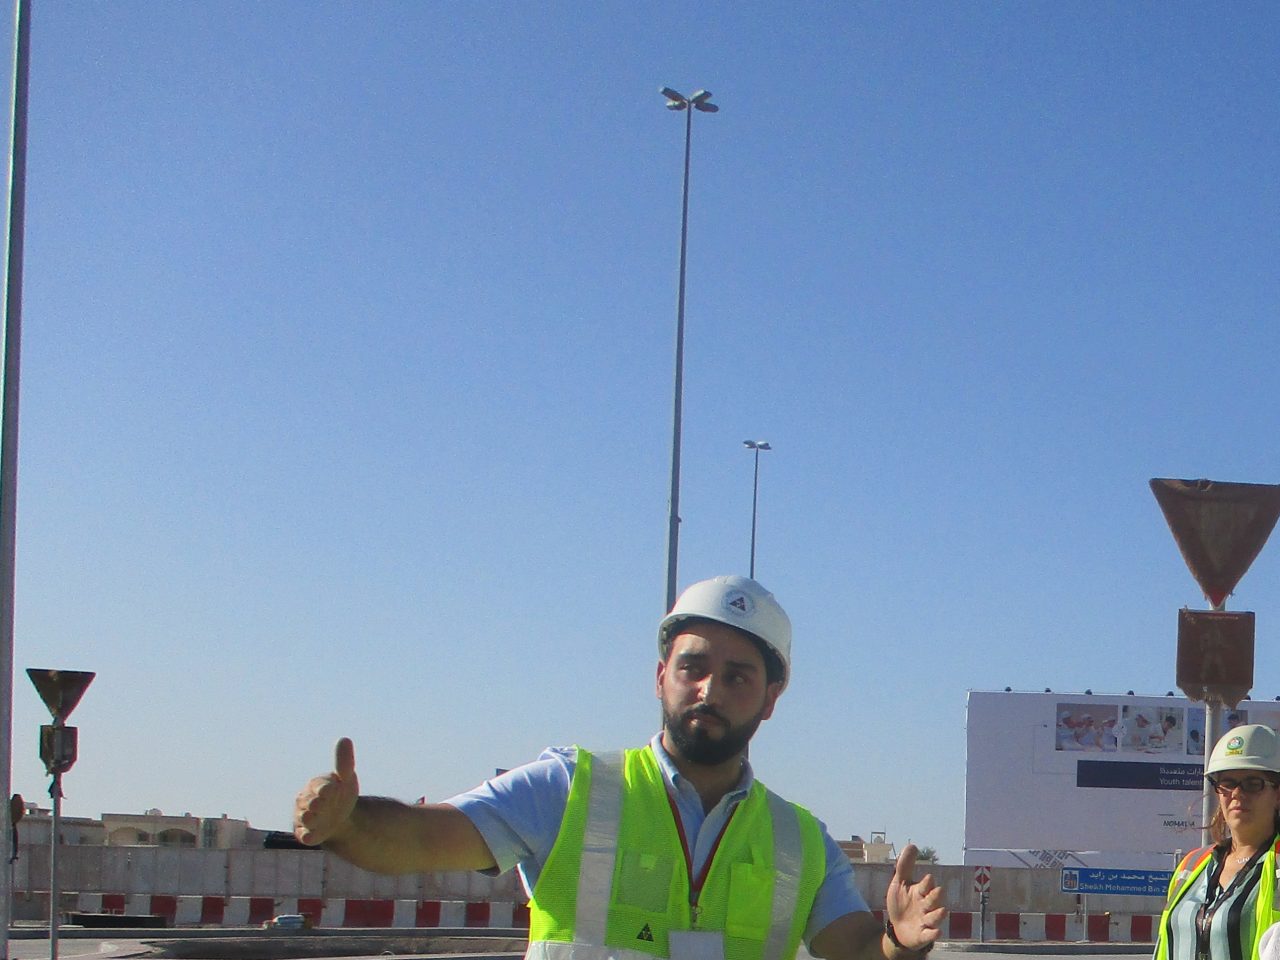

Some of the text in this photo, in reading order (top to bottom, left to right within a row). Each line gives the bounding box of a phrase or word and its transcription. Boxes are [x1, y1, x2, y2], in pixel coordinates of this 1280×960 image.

[1089, 871, 1105, 880] زايد
[1108, 873, 1118, 881] بن
[1080, 882, 1104, 891] Sheikh
[1105, 884, 1147, 892] Mohammed
[1147, 885, 1160, 893] Bin
